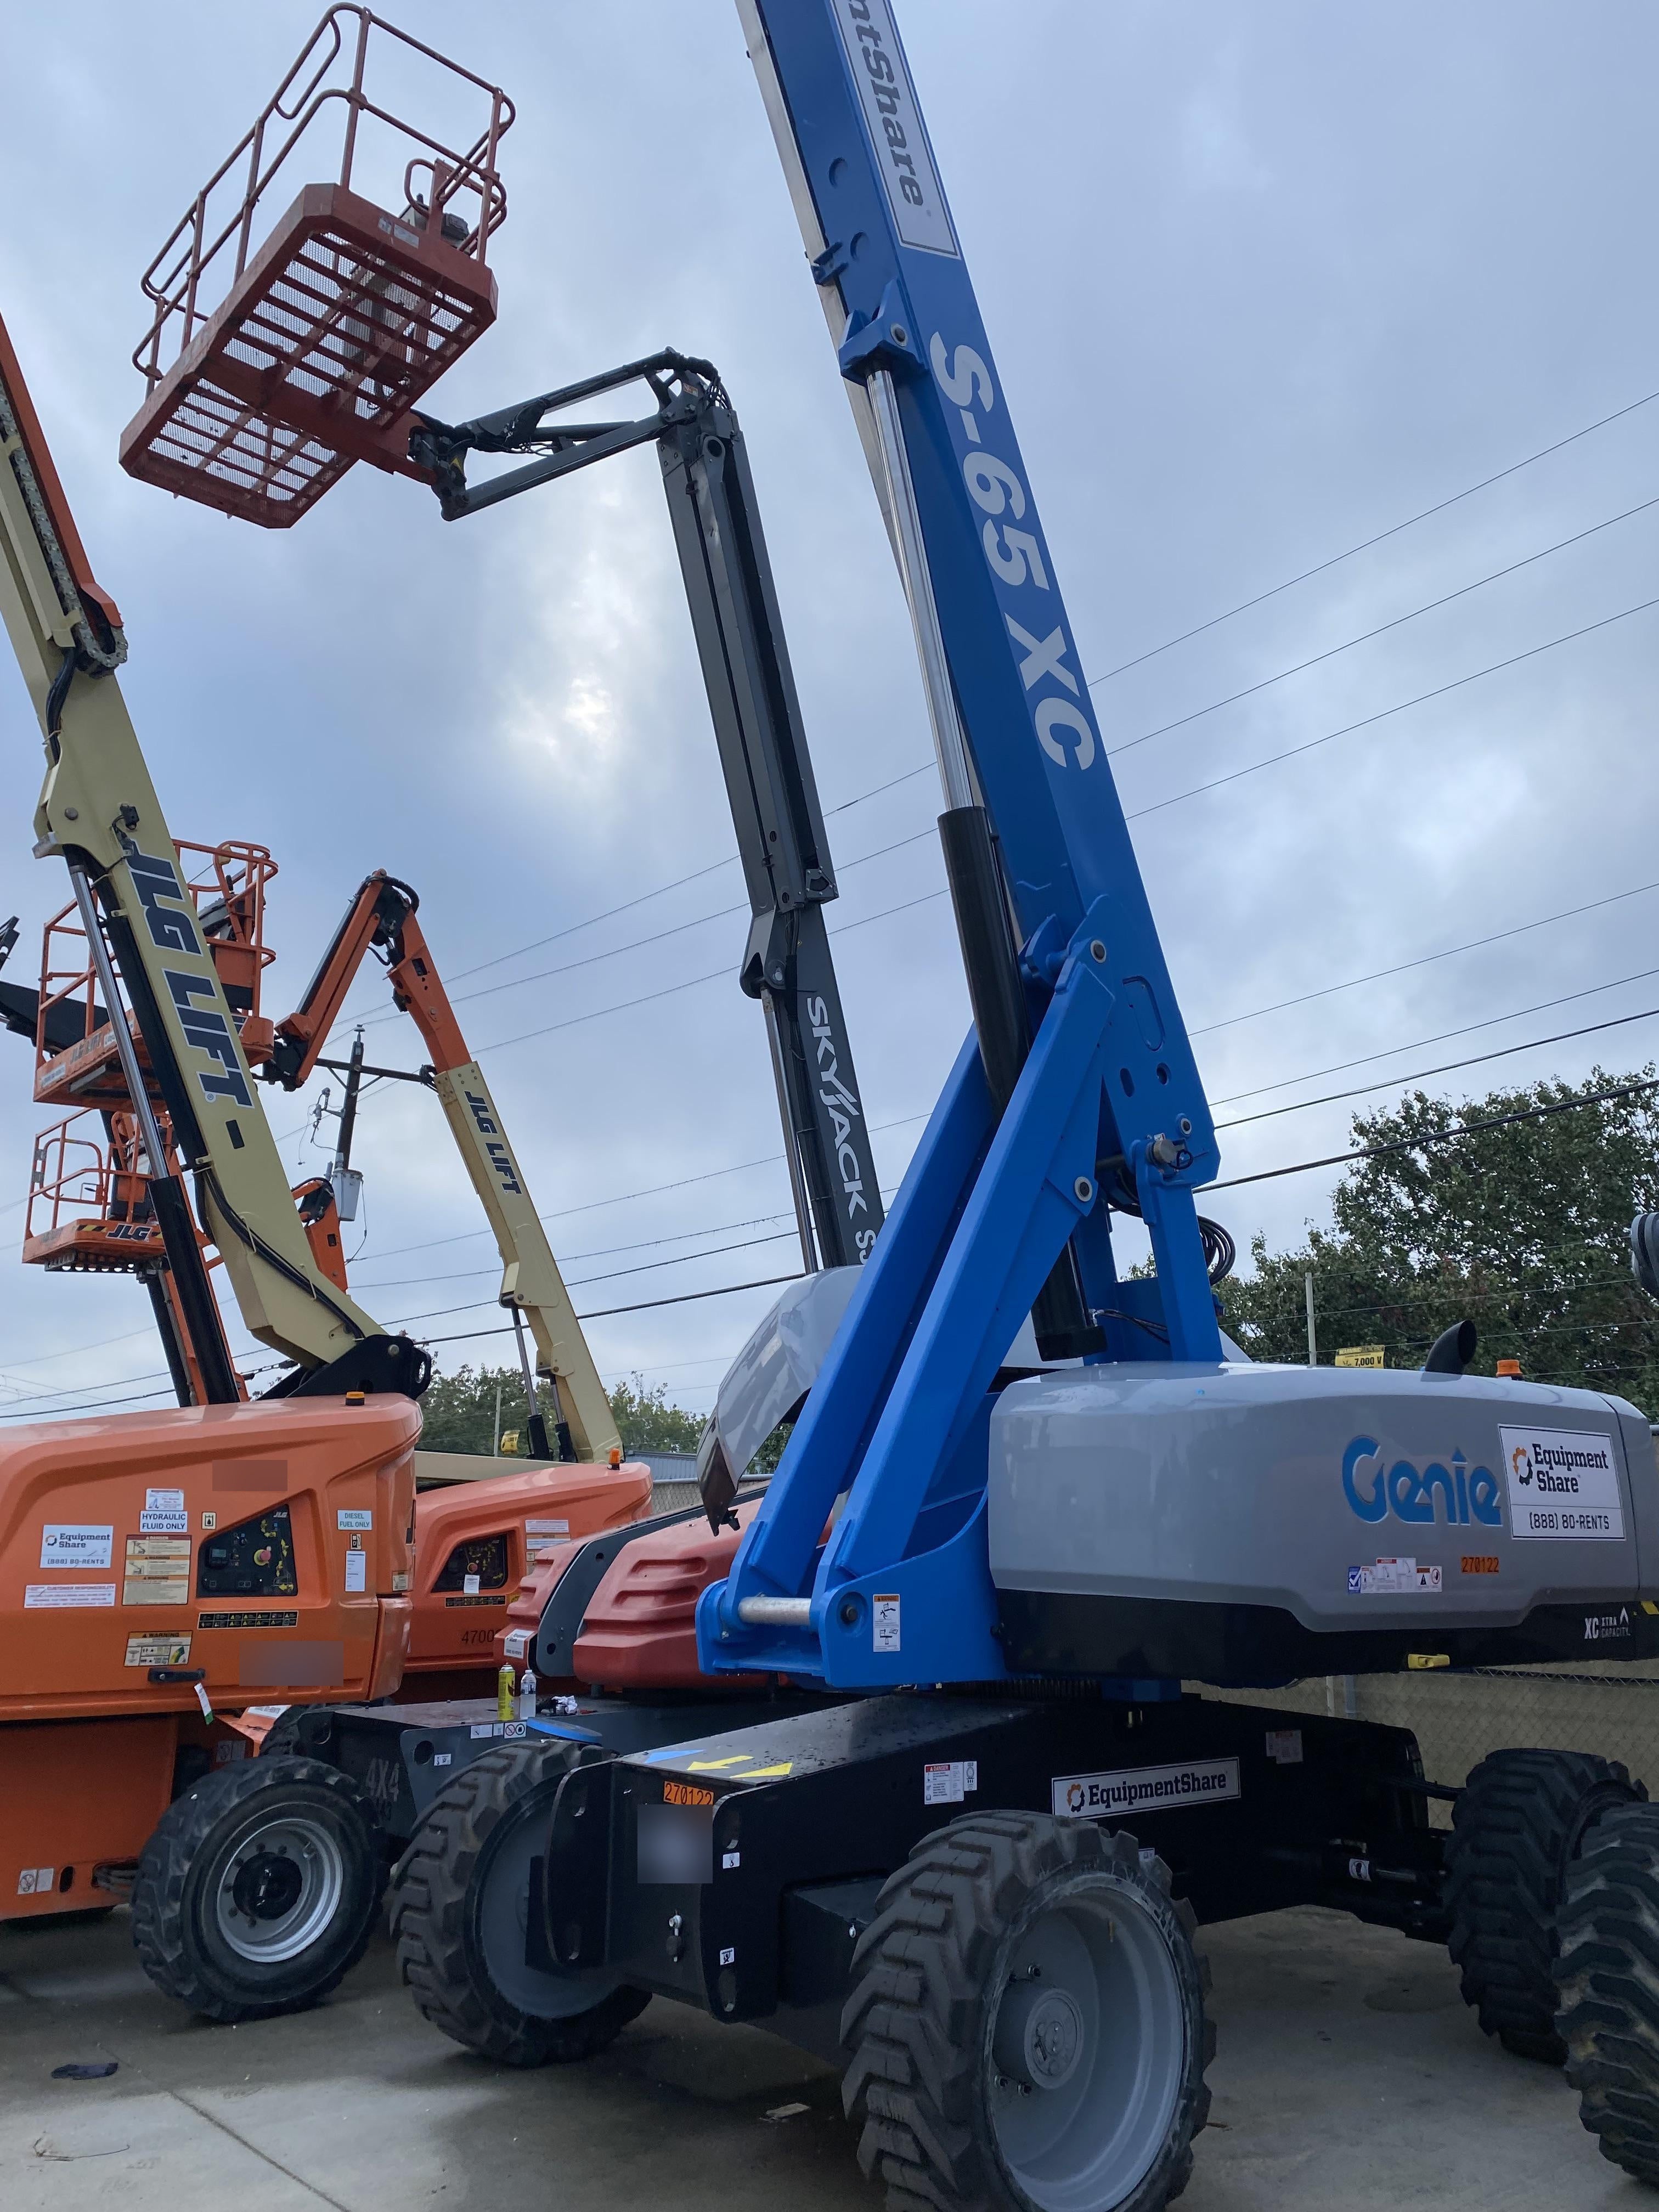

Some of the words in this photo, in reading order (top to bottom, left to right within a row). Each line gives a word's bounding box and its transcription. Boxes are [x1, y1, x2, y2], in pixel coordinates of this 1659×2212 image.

[930, 331, 1050, 591] S-65
[1005, 612, 1095, 770] XC
[127, 839, 204, 957] JLG
[162, 968, 255, 1109] LIFT
[807, 996, 868, 1220] SKYJACK
[464, 1090, 498, 1134] JLG
[485, 1142, 522, 1194] LIFT
[105, 1223, 153, 1242] JLG
[1355, 1357, 1374, 1368] 7,000
[1532, 1443, 1609, 1471] Equipment
[1342, 1435, 1503, 1527] Genie
[1537, 1470, 1579, 1493] Share
[1530, 1512, 1559, 1530] (888)
[1562, 1514, 1610, 1530] 80-RENTS
[59, 1533, 110, 1542] Equipment
[1462, 1557, 1499, 1573] 270122
[1584, 1617, 1599, 1639] XC
[1088, 1773, 1227, 1809] EquipmentShare
